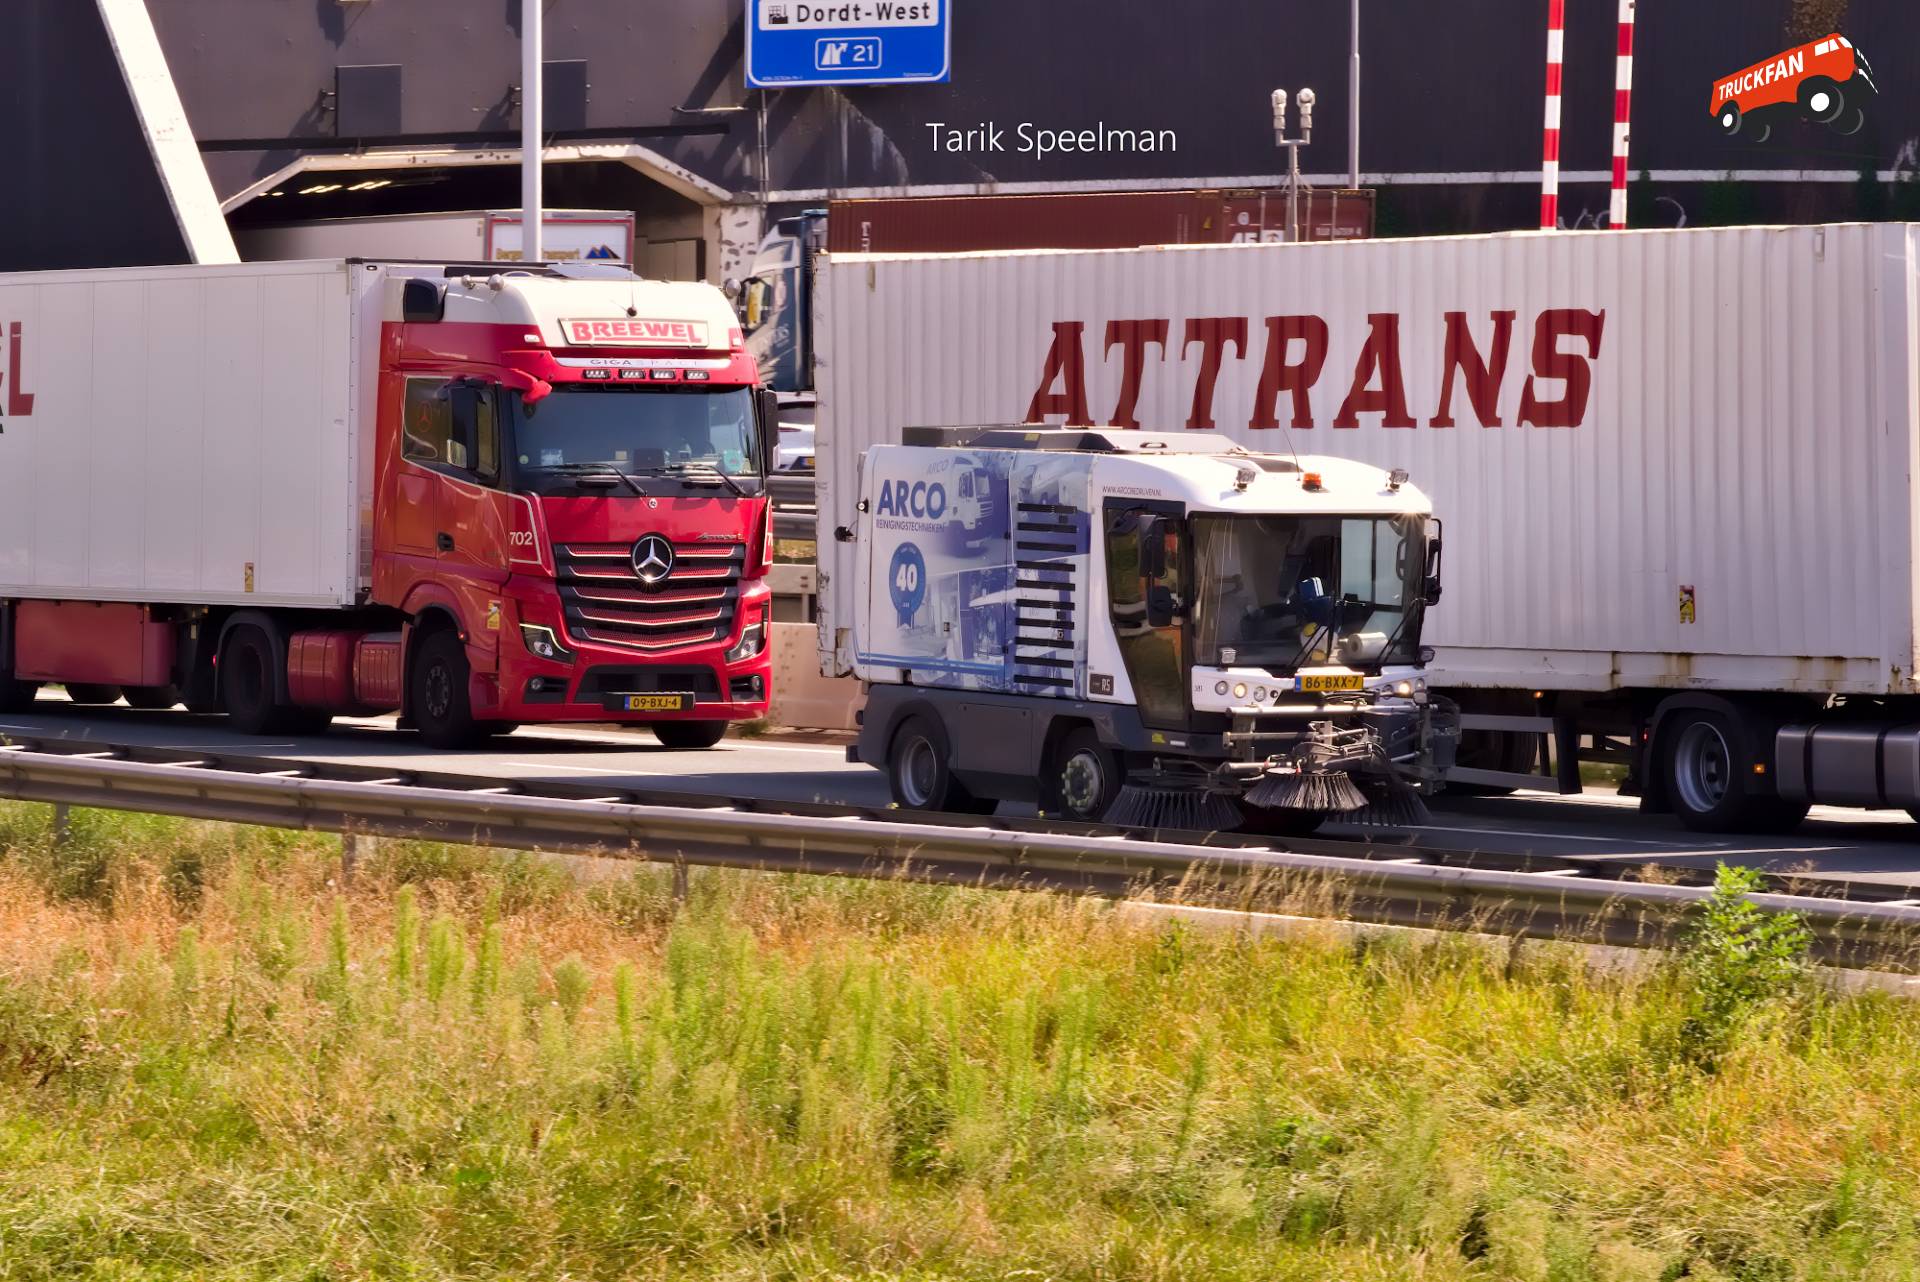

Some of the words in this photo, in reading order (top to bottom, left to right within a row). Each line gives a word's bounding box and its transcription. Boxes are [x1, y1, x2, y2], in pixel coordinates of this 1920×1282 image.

[796, 1, 931, 23] Dordt-West
[852, 44, 874, 62] 21
[571, 321, 703, 344] BREEWEL
[1025, 308, 1606, 430] ATTRANS
[876, 479, 947, 520] ARCO
[509, 531, 534, 546] 702
[895, 563, 918, 593] 40
[1305, 675, 1359, 689] 86-BXX-7
[632, 697, 678, 708] 09-BXJ-4
